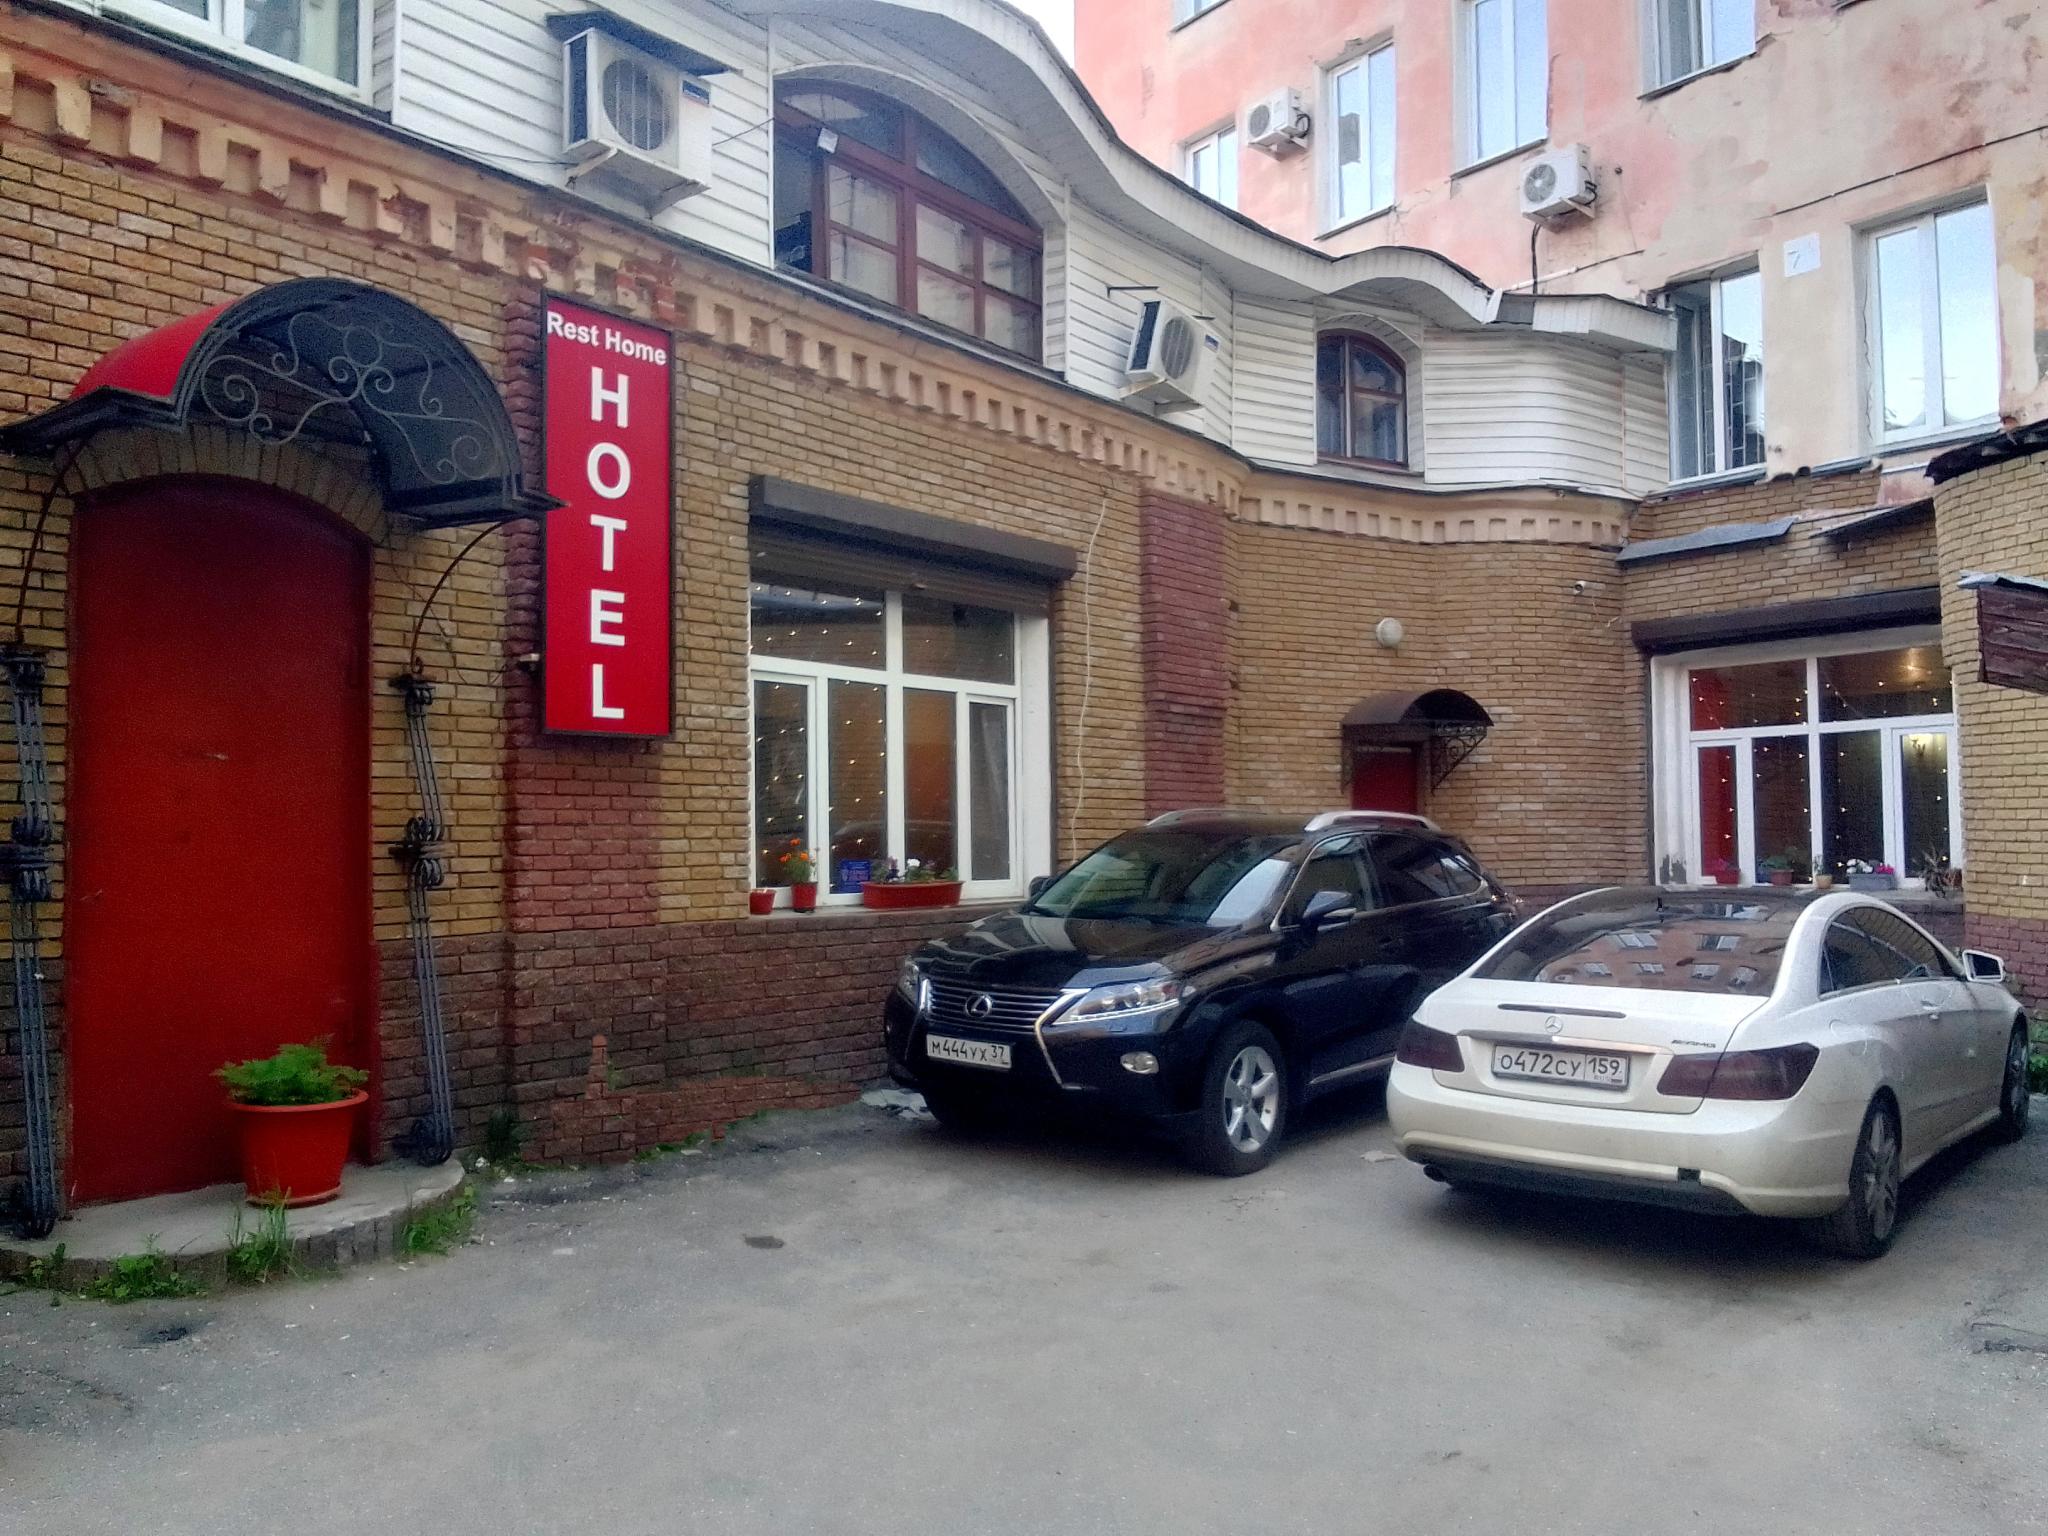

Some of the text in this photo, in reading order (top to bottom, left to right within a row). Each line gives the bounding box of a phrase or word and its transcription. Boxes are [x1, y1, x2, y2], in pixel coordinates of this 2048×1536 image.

[547, 311, 667, 365] Rest Home
[587, 366, 631, 719] HOTEL
[1587, 1057, 1620, 1076] 159
